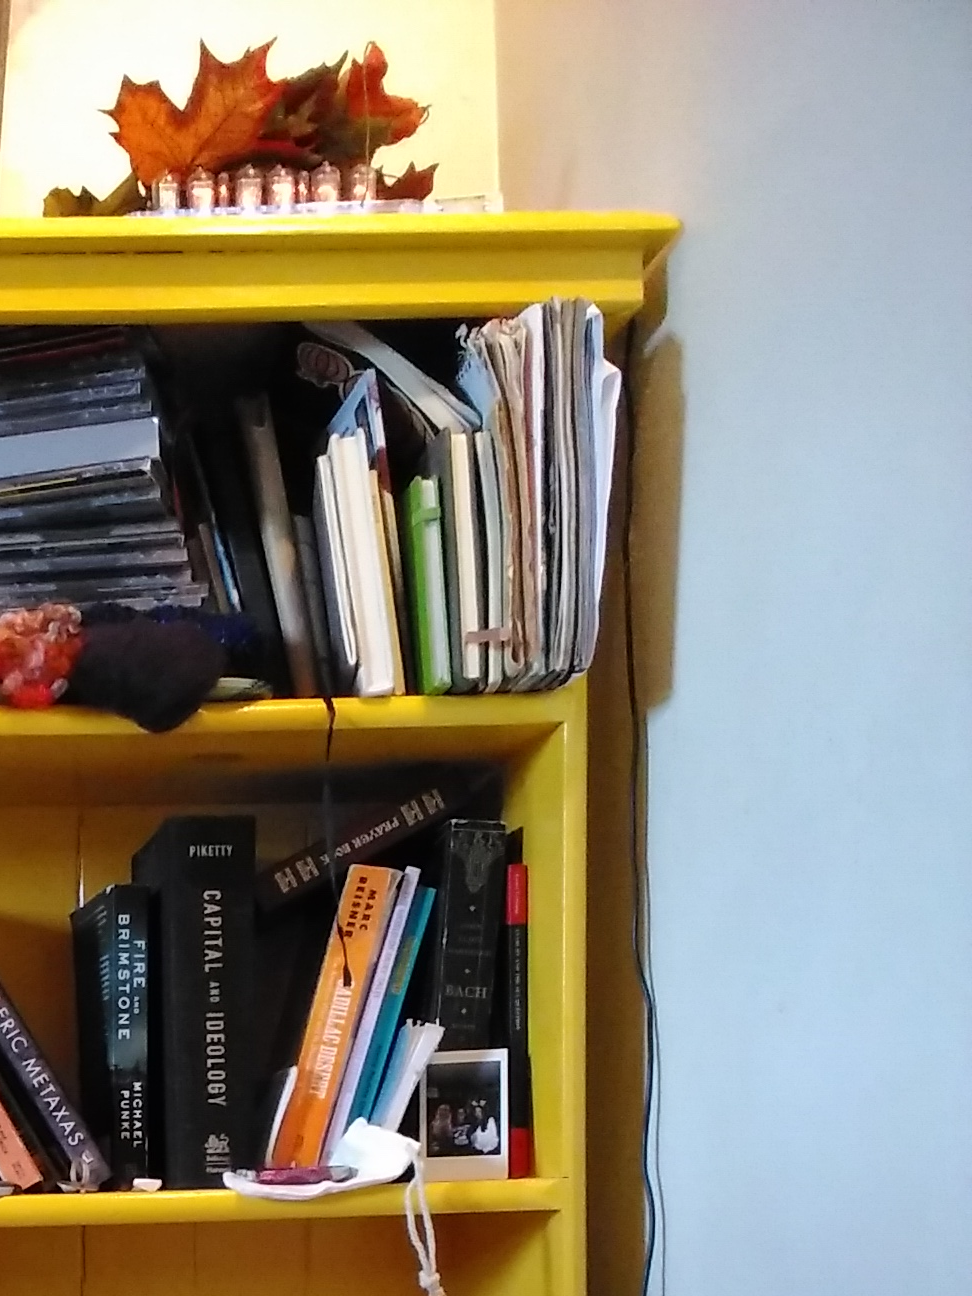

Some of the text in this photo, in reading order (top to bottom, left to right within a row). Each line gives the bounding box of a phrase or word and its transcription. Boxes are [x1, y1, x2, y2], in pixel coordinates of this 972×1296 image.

[189, 845, 232, 857] PIKETTY
[320, 843, 350, 865] BOK
[342, 877, 369, 936] REISNER
[358, 890, 379, 930] MARC
[114, 912, 133, 1039] BRIMSTONE
[131, 939, 146, 987] FIRE
[202, 889, 226, 1106] CAPITAL AND IDEOLOGY
[444, 984, 487, 998] BACH
[21, 1056, 84, 1145] METAXAS
[118, 1089, 130, 1140] PUNKE
[130, 1080, 143, 1148] MICHAEL
